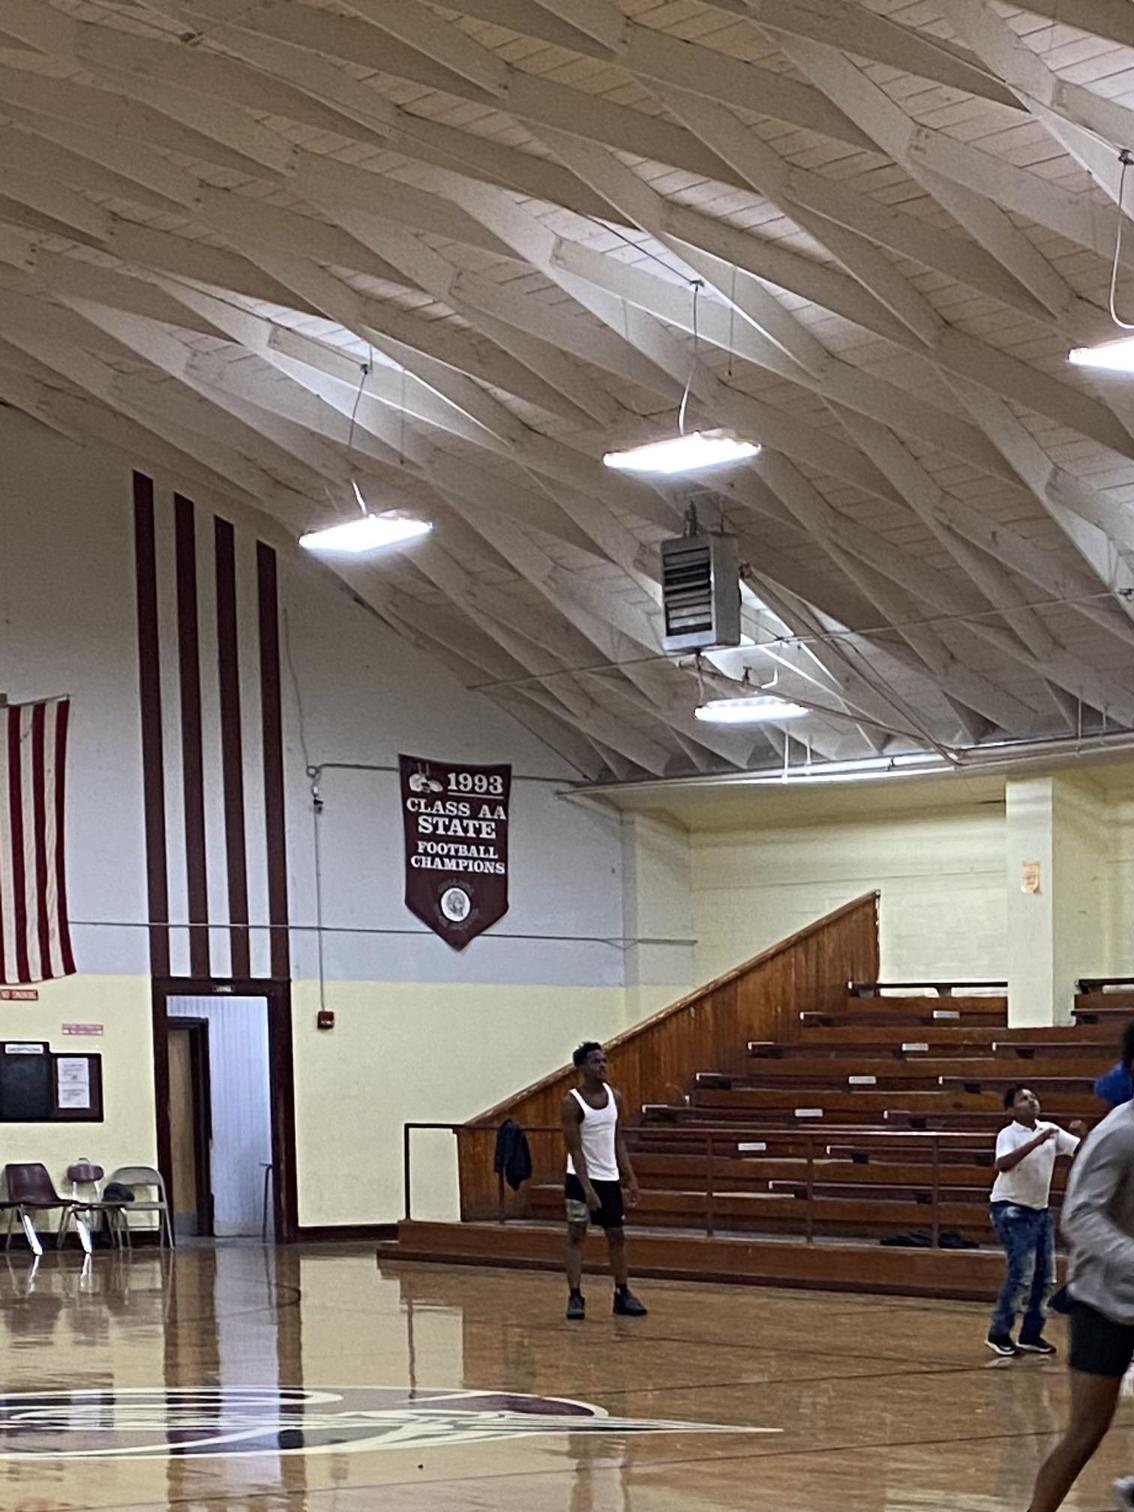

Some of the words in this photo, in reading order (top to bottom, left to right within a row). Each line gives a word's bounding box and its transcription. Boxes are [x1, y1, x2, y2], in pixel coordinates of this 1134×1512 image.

[448, 773, 503, 794] 1993
[407, 798, 470, 816] CLASS
[478, 804, 506, 819] AA
[418, 816, 496, 839] STATE
[417, 841, 498, 859] FOOTBALL
[411, 855, 505, 874] CHAMPIONS
